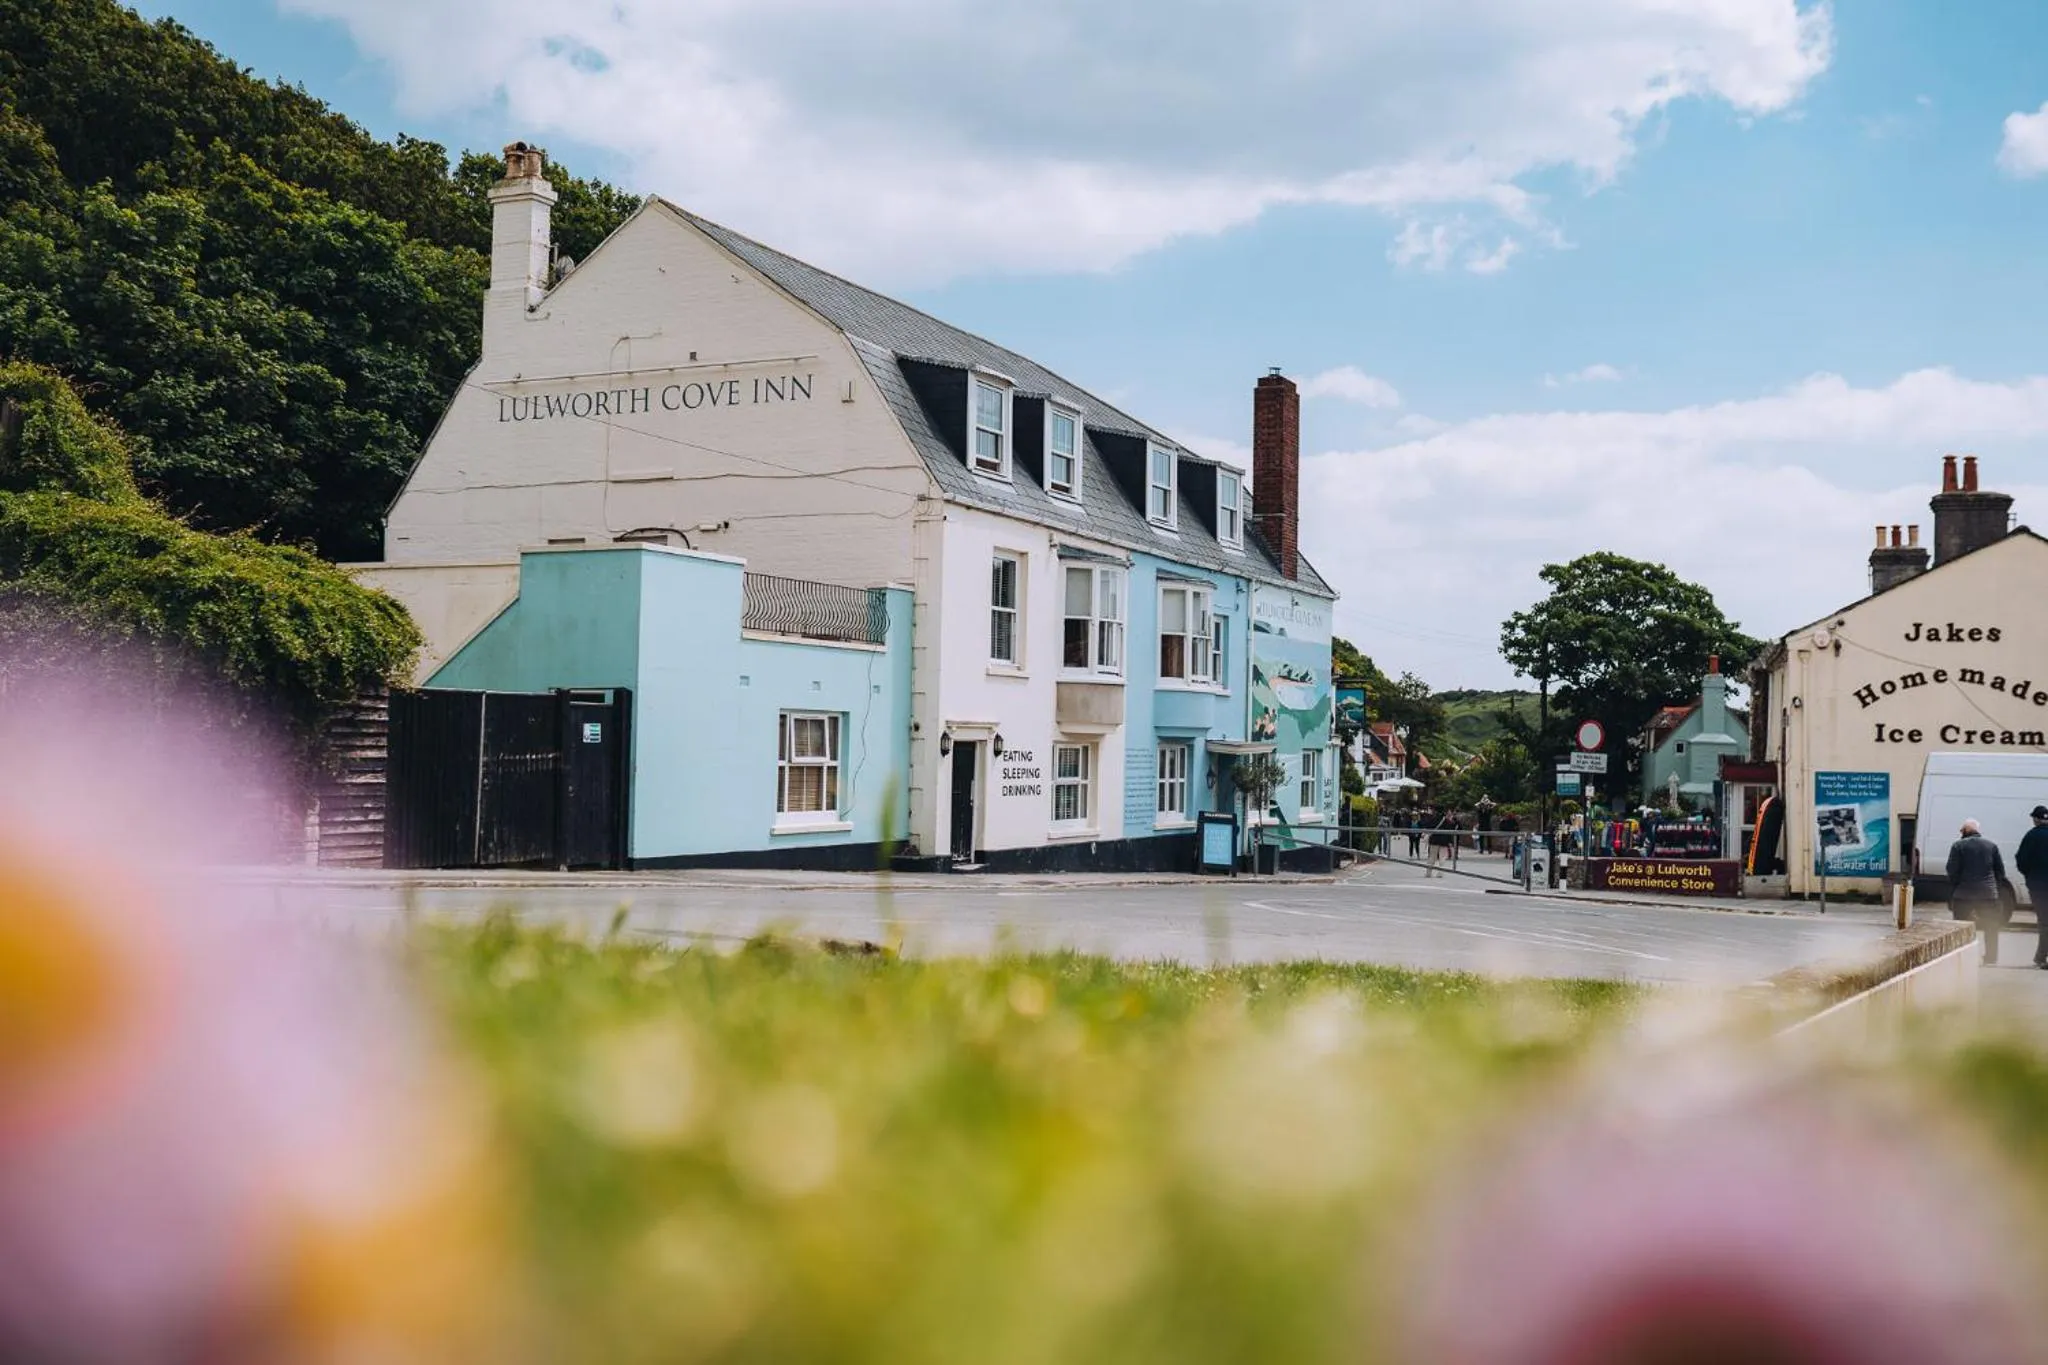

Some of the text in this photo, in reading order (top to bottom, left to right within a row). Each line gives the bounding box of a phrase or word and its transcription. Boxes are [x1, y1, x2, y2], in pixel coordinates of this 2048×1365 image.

[499, 374, 813, 422] LULWORTH COVE INN
[1904, 622, 2002, 642] Jakes
[1874, 723, 2046, 746] Ice Cream
[1003, 750, 1033, 762] EATING
[1002, 767, 1040, 780] SLEEPING
[1001, 784, 1041, 797] DRINKING
[1610, 862, 1643, 873] Jake's
[1658, 864, 1712, 876] Lulworth
[1607, 876, 1715, 891] Convenience Store
